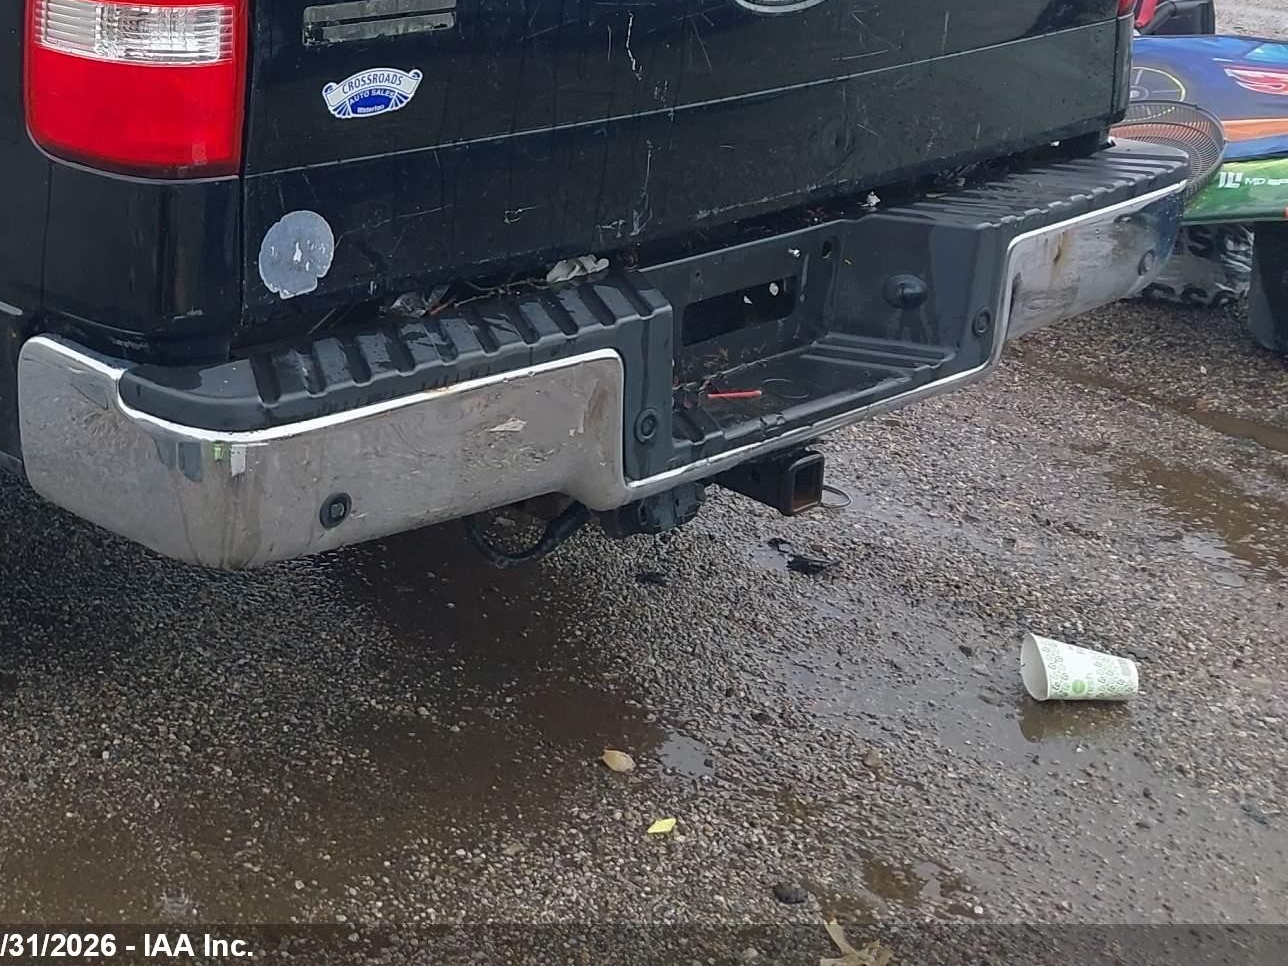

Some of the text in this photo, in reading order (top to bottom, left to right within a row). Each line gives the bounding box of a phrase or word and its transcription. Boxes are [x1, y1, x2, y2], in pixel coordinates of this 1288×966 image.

[342, 72, 404, 95] CROSSROADS
[349, 89, 396, 105] AUTO SALES
